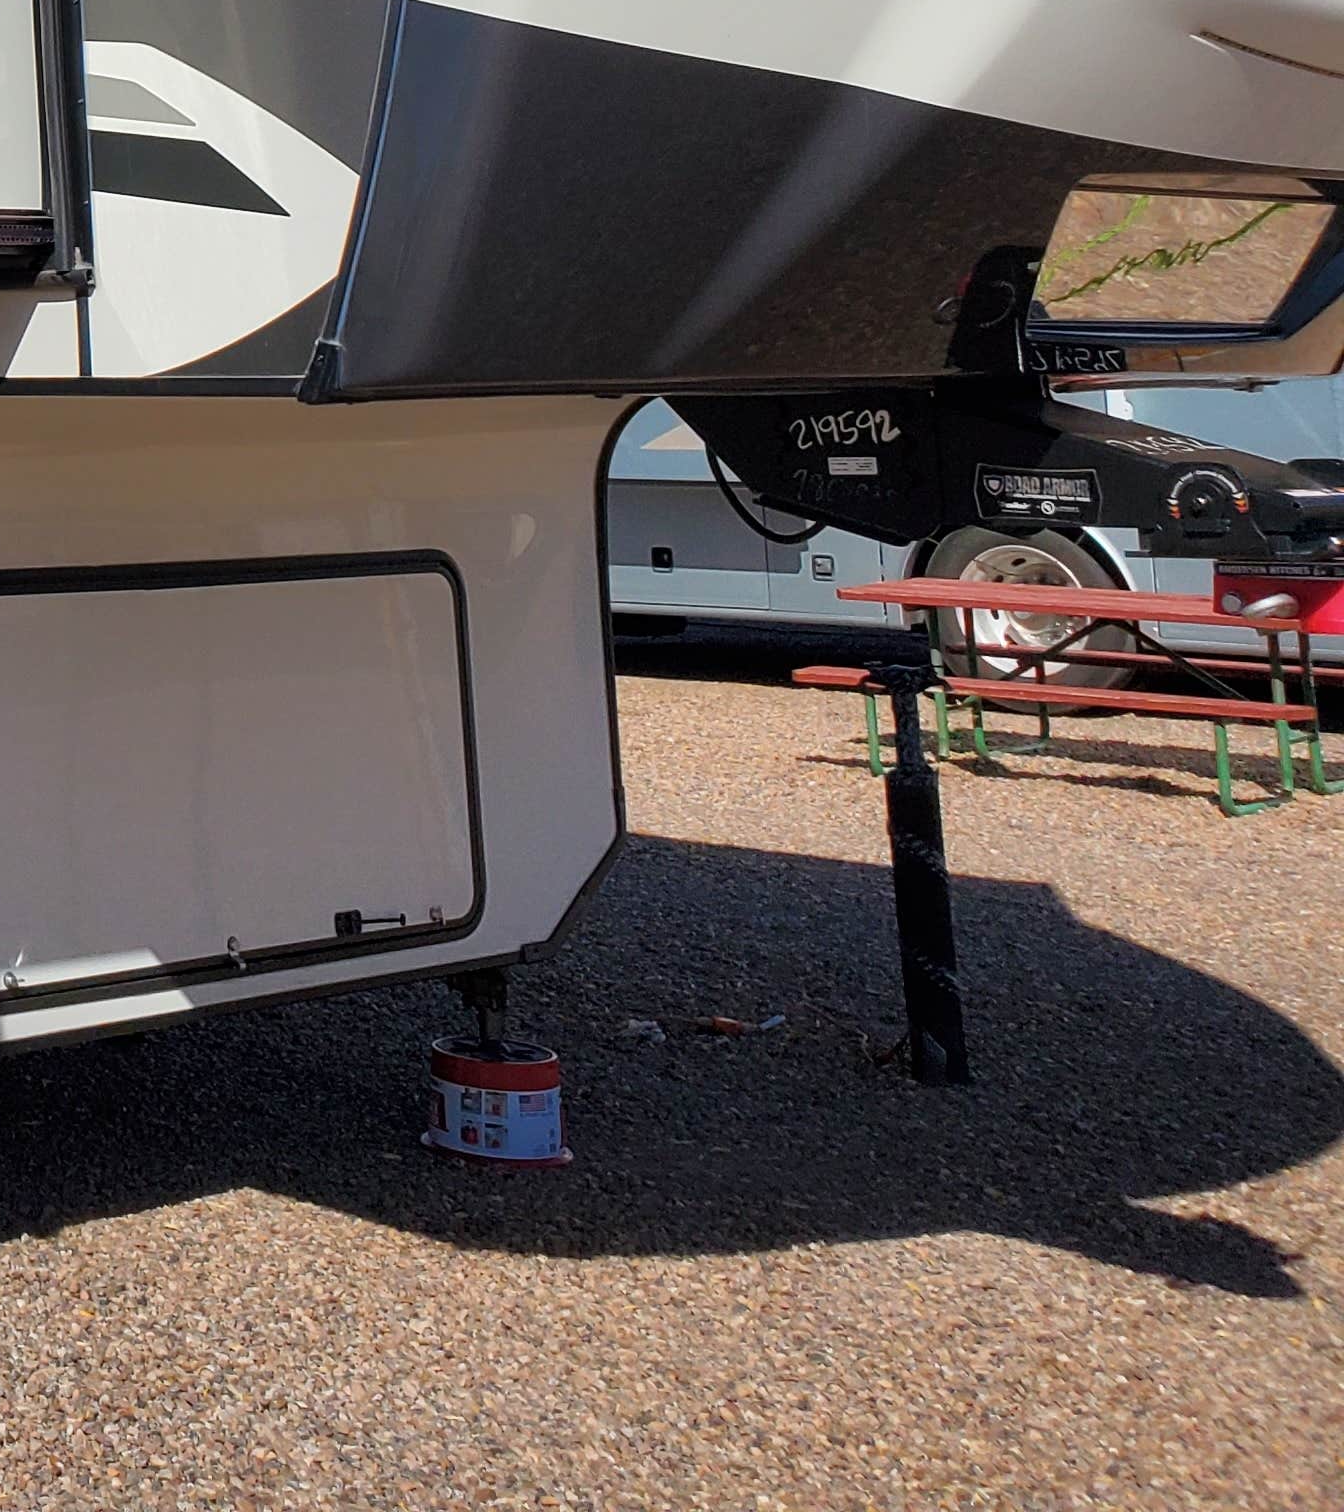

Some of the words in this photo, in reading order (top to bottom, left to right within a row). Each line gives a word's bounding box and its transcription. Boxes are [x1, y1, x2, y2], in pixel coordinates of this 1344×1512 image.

[788, 409, 901, 450] 219592
[1004, 474, 1041, 494] ROAD
[1042, 476, 1091, 499] ARMOR
